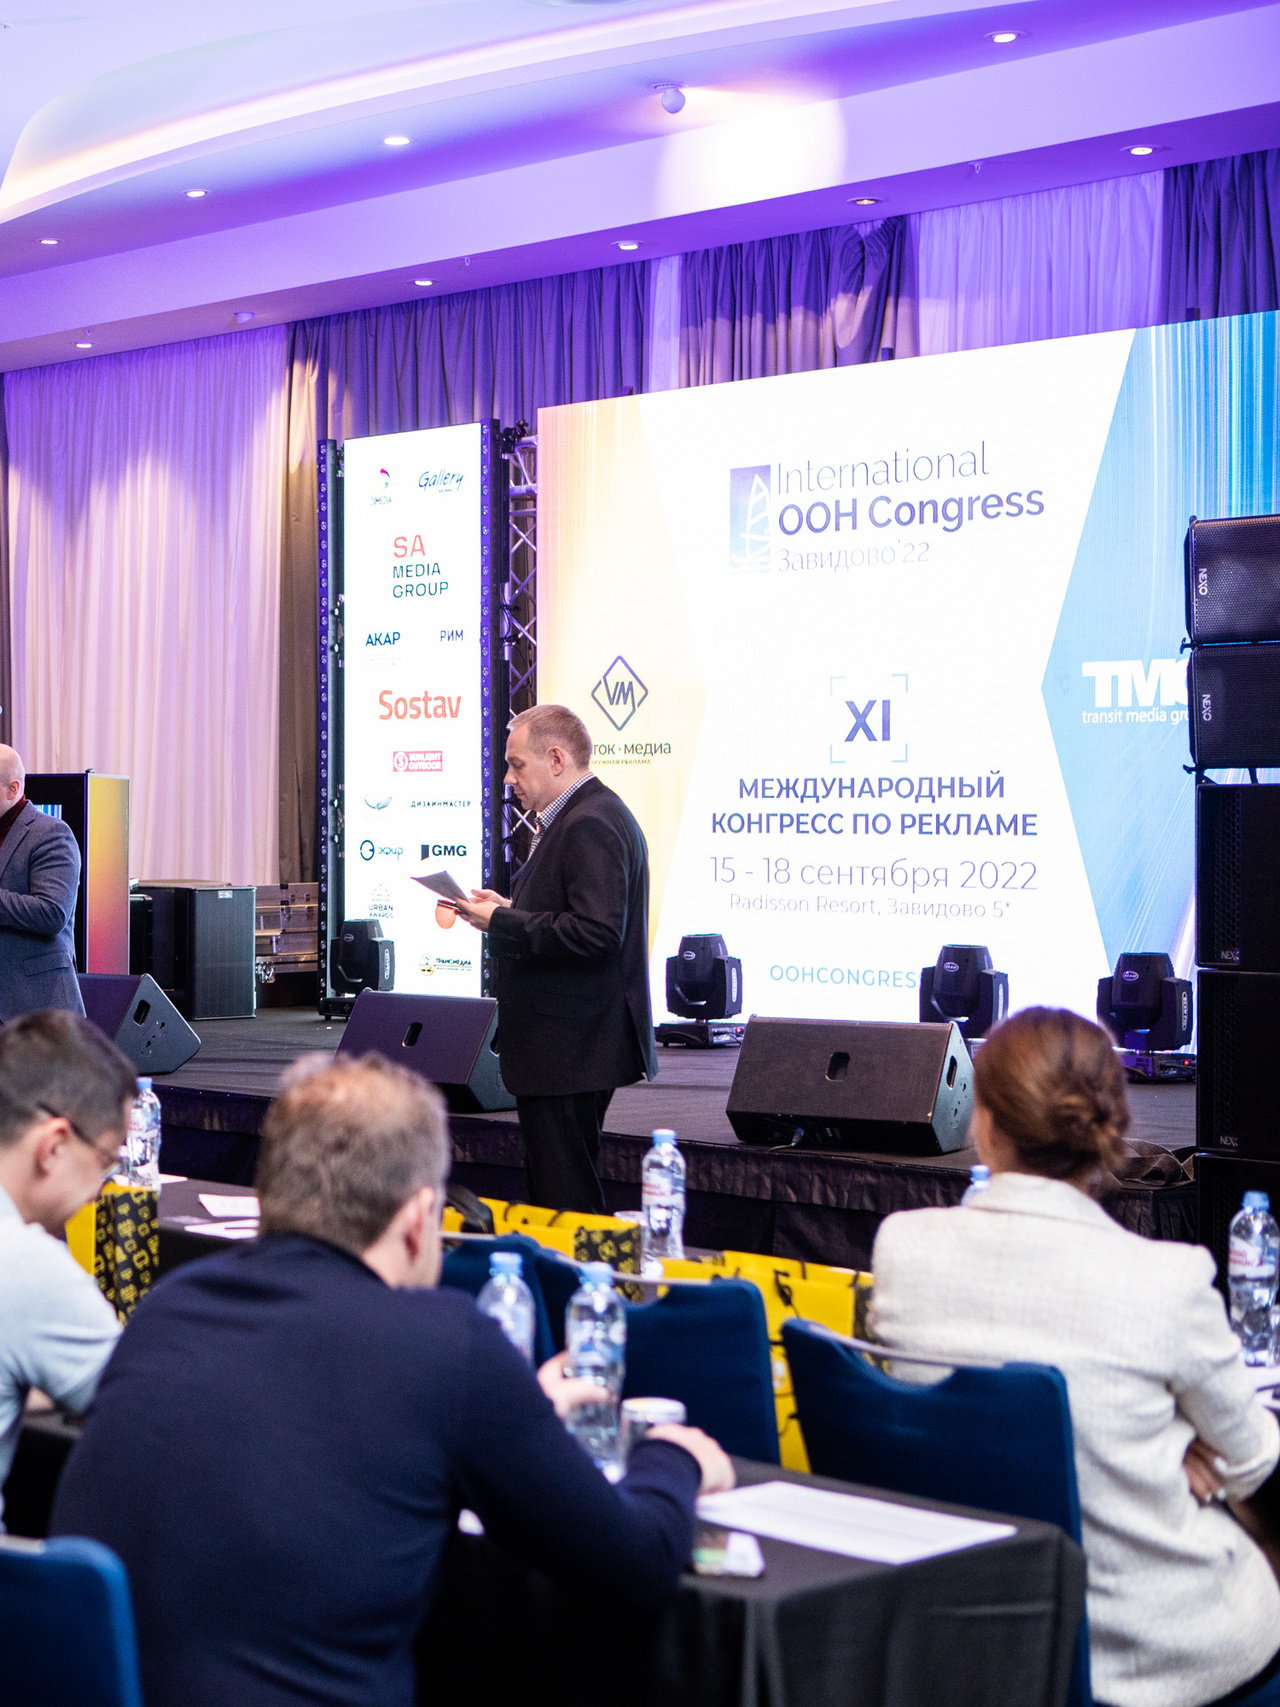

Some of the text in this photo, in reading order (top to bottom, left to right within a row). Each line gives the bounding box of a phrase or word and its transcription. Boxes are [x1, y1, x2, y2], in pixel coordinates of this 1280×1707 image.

[418, 469, 464, 491] Gallery
[778, 440, 989, 495] International
[778, 489, 1045, 536] OOH Congress
[393, 535, 426, 558] SA
[393, 562, 441, 579] MEDIA
[1198, 568, 1209, 596] NEXO
[393, 581, 449, 599] GROUP
[440, 629, 464, 642] РИМ
[378, 689, 462, 720] Sostav
[1082, 709, 1123, 724] transit
[1126, 708, 1167, 723] media
[1202, 694, 1212, 722] NEXO
[844, 699, 891, 742] XI
[593, 743, 616, 756] ток
[739, 770, 1005, 804] МЕЖДУНАРОДНЫЙ
[712, 812, 1038, 836] КОНГРЕСС ПО РЕКЛАМЕ
[432, 844, 467, 857] GMG
[710, 856, 736, 884] 15
[762, 856, 791, 885] 18
[800, 857, 948, 894] сентября
[959, 860, 1038, 891] 2022
[730, 893, 810, 912] Radisson
[816, 896, 881, 916] Resort,
[887, 897, 987, 919] Завидово
[770, 964, 918, 989] OOHCONGRES
